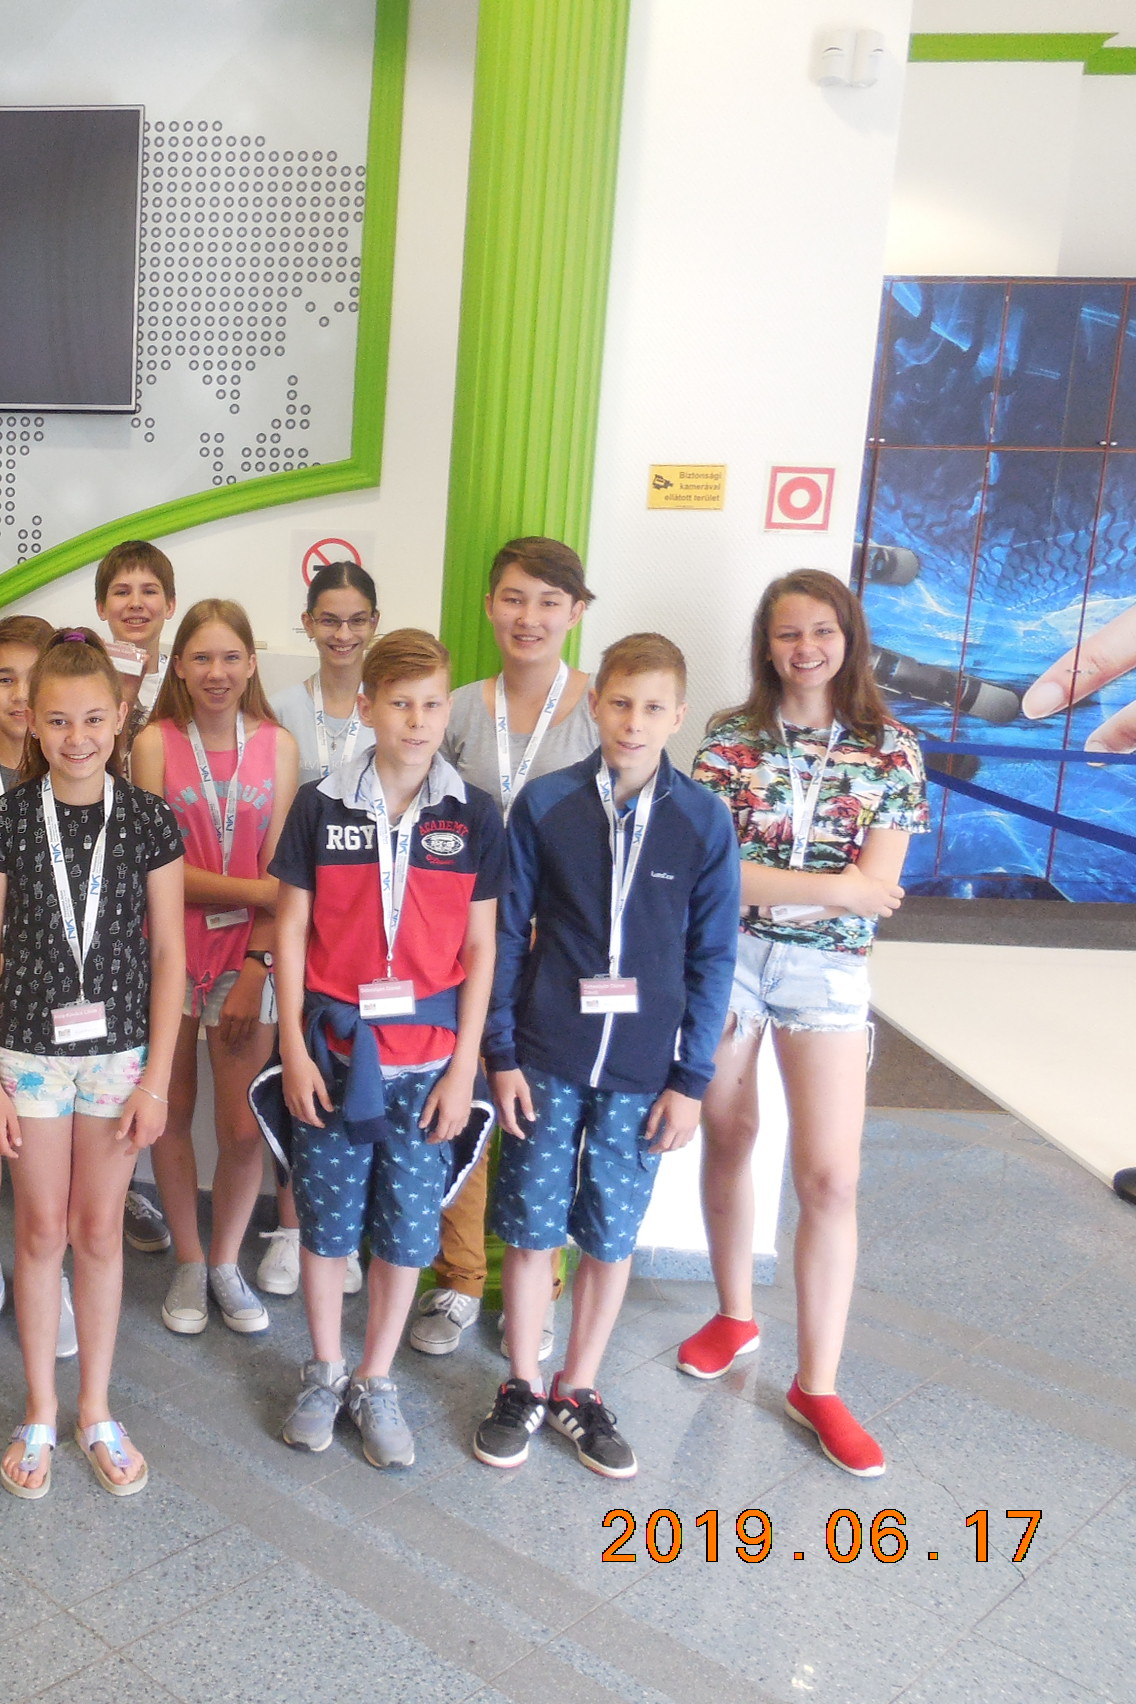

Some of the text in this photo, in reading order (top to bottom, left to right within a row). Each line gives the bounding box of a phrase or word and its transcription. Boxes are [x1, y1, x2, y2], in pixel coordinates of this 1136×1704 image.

[679, 472, 722, 480] Biztonsági
[693, 494, 720, 502] terület
[419, 820, 469, 838] ACADEMY
[326, 825, 376, 851] RGY
